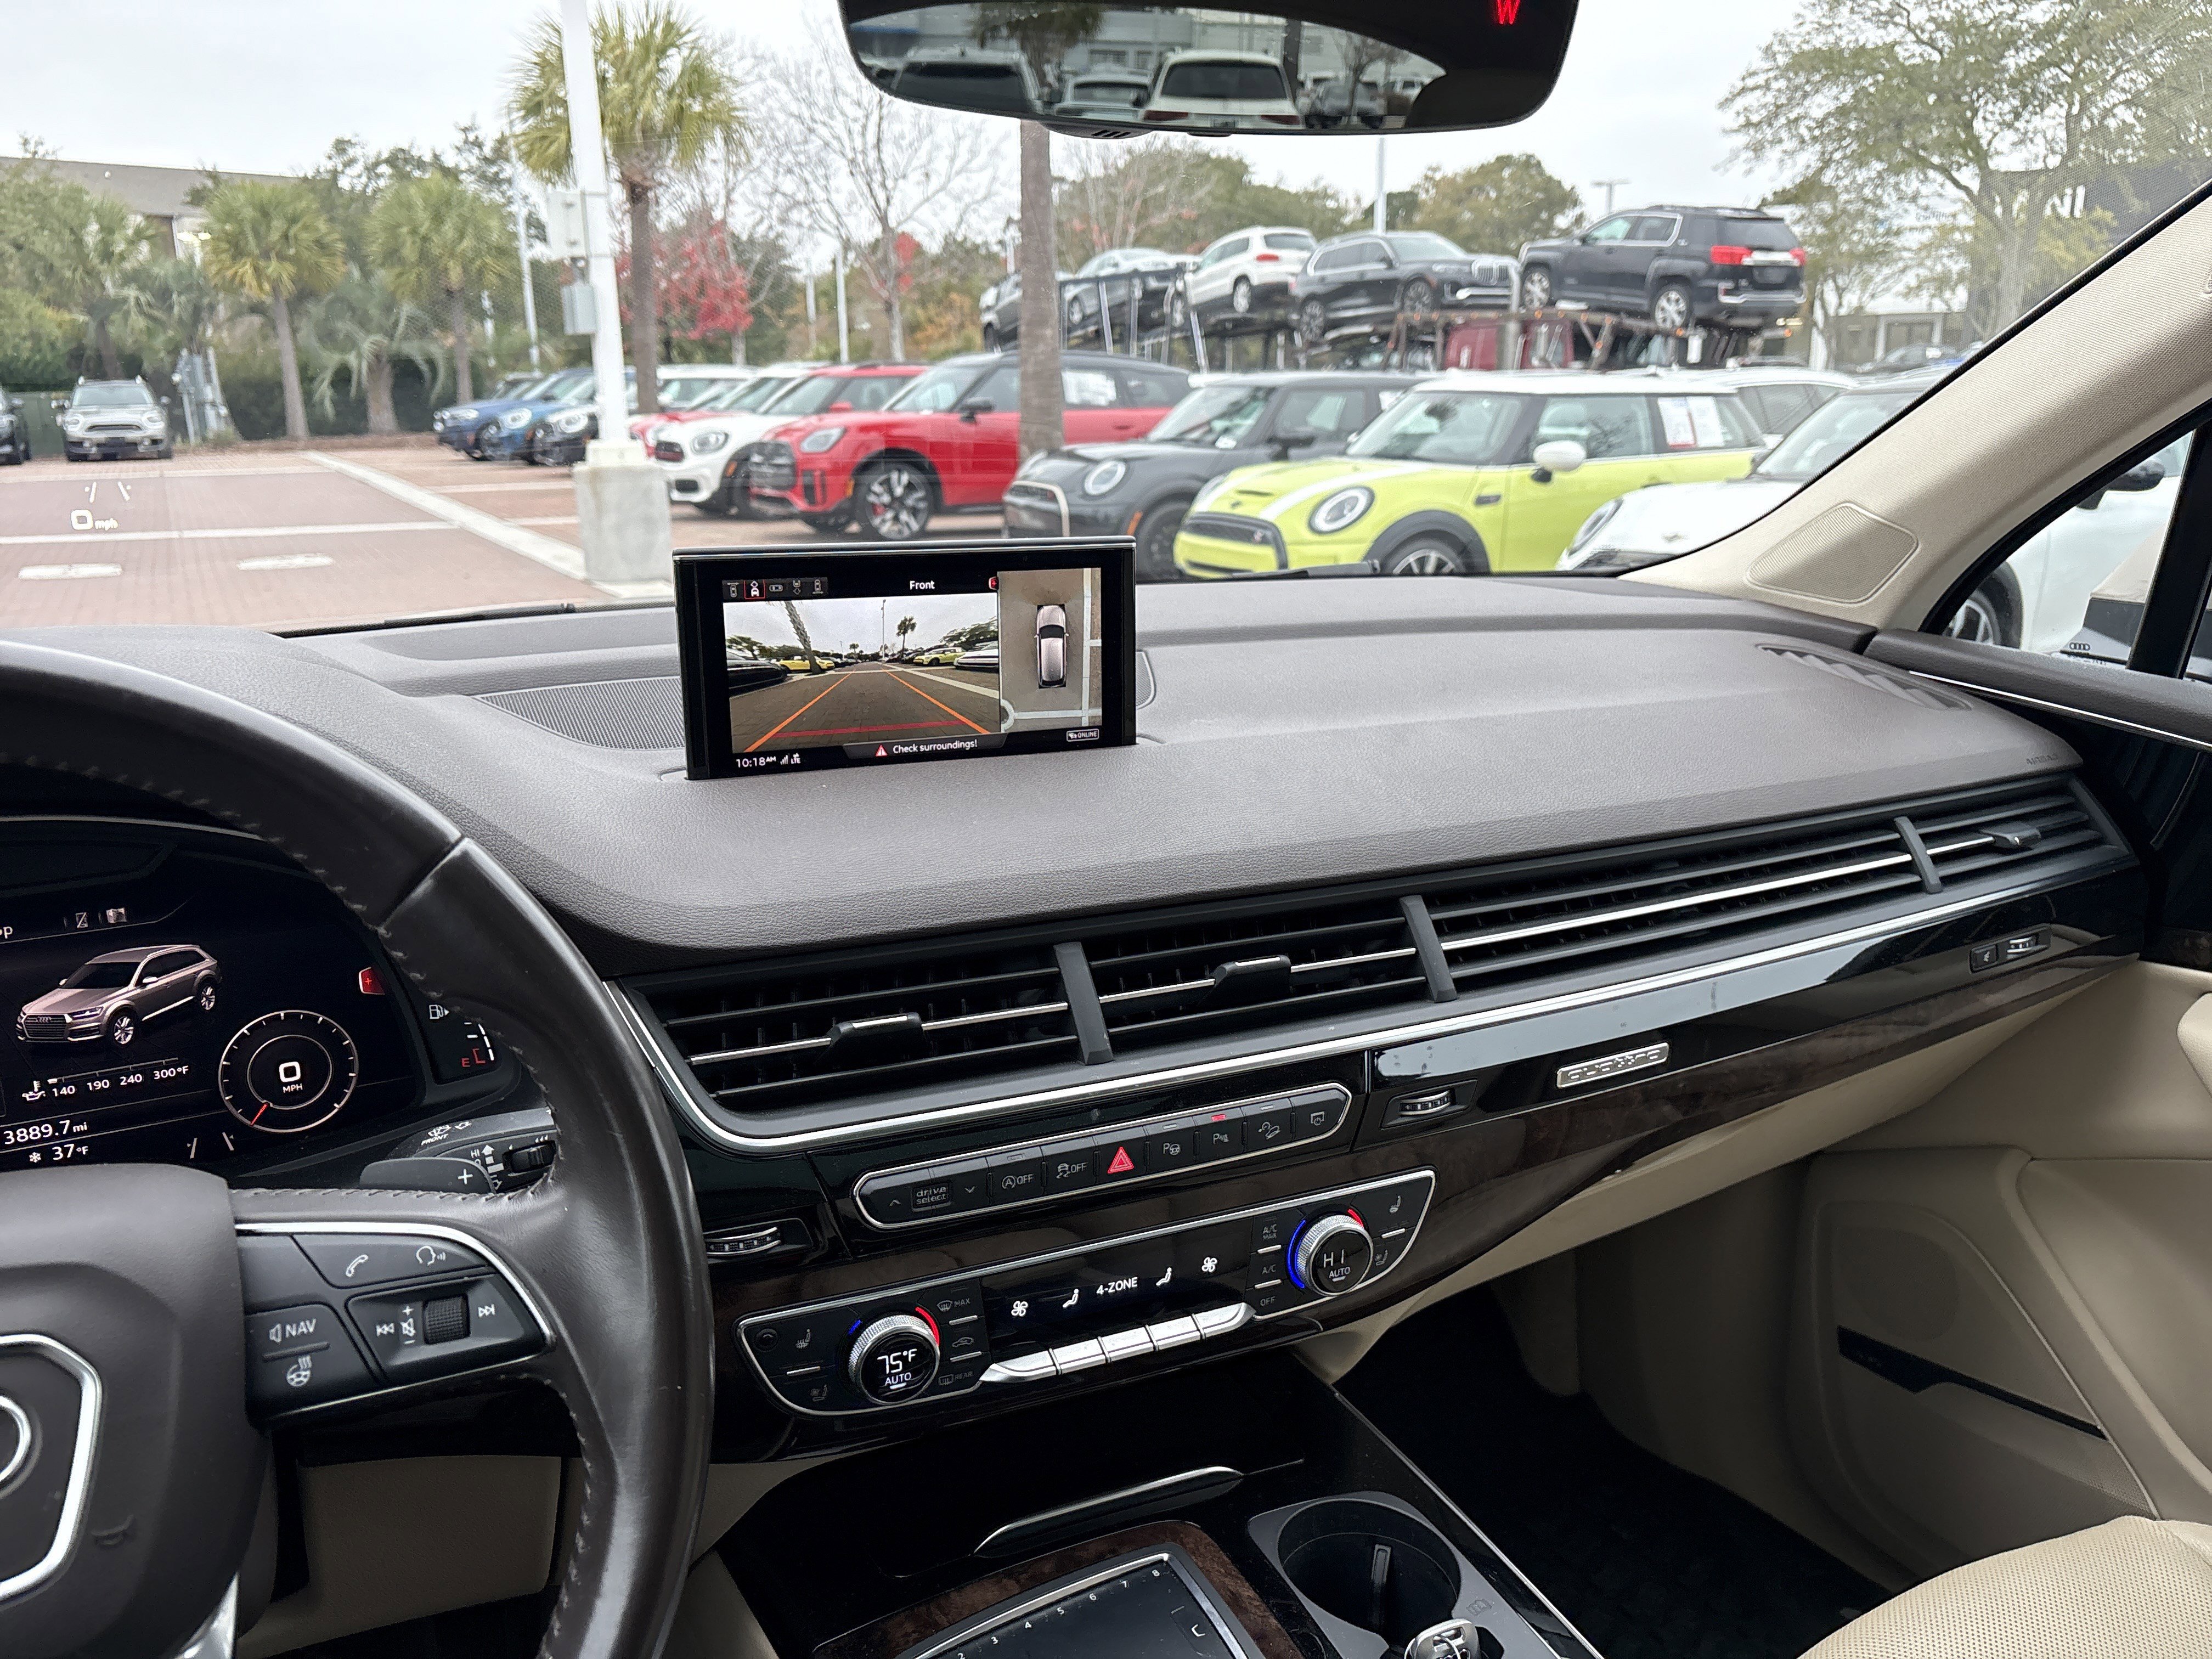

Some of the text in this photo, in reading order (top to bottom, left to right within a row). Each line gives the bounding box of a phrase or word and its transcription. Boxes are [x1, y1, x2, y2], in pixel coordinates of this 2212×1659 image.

[910, 580, 935, 590] Front
[893, 738, 978, 754] Check surroundings!
[461, 1057, 471, 1068] E
[279, 1061, 301, 1082] 0
[52, 1085, 75, 1097] 140
[87, 1079, 110, 1091] 190
[120, 1074, 143, 1086] 240
[283, 1083, 303, 1093] MPH
[421, 1133, 449, 1146] FRONT
[52, 1143, 88, 1160] 37°F
[470, 1148, 481, 1159] HI
[1070, 1161, 1087, 1173] OFF
[1017, 1173, 1033, 1186] OFF
[916, 1187, 947, 1197] drive
[916, 1194, 947, 1205] select
[1263, 1224, 1277, 1234] A/C
[1323, 1249, 1345, 1268] HI
[1262, 1264, 1276, 1274] A/C
[1328, 1266, 1351, 1279] AUTO
[1096, 1277, 1138, 1295] 4-ZONE
[953, 1297, 970, 1308] MAX
[1260, 1296, 1276, 1306] OFF
[285, 1319, 317, 1338] NAV
[877, 1348, 917, 1374] 75°F
[885, 1372, 912, 1386] AUTO
[990, 1636, 998, 1645] 3
[1056, 1606, 1064, 1615] 5
[1121, 1580, 1127, 1588] 7
